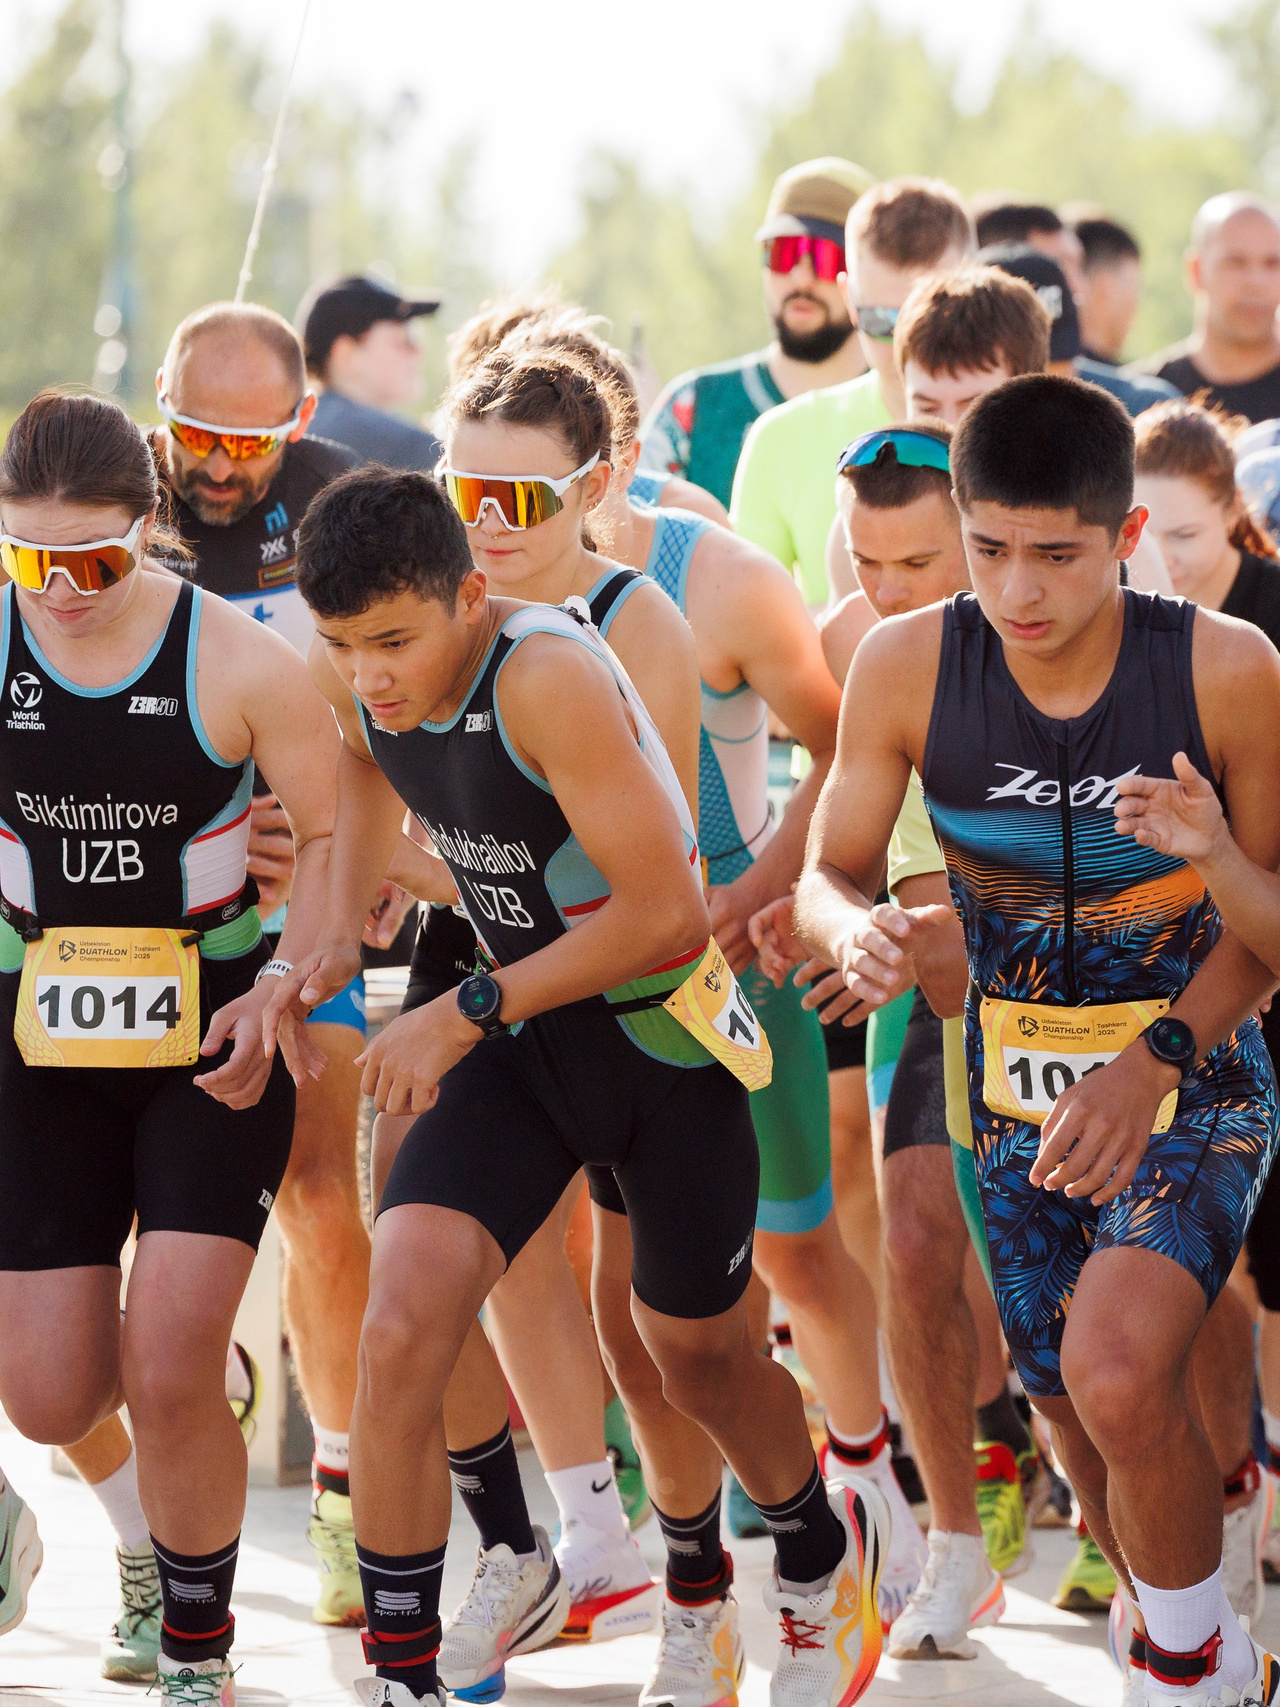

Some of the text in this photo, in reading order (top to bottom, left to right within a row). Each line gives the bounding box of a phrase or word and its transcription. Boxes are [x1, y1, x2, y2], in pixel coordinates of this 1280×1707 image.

[12, 711, 39, 721] World
[6, 720, 45, 730] Triathlon
[15, 791, 178, 830] Biktimirova
[62, 838, 145, 884] UZB
[463, 875, 534, 929] UZB
[79, 948, 127, 956] DUATHLON
[79, 955, 121, 963] Championship
[38, 985, 182, 1030] 1014
[1041, 1018, 1073, 1026] Uzbekistan
[1096, 1021, 1127, 1029] Tashkent
[1042, 1026, 1090, 1035] DUATHLON
[1043, 1033, 1084, 1041] Championship
[374, 1607, 421, 1617] sportful
